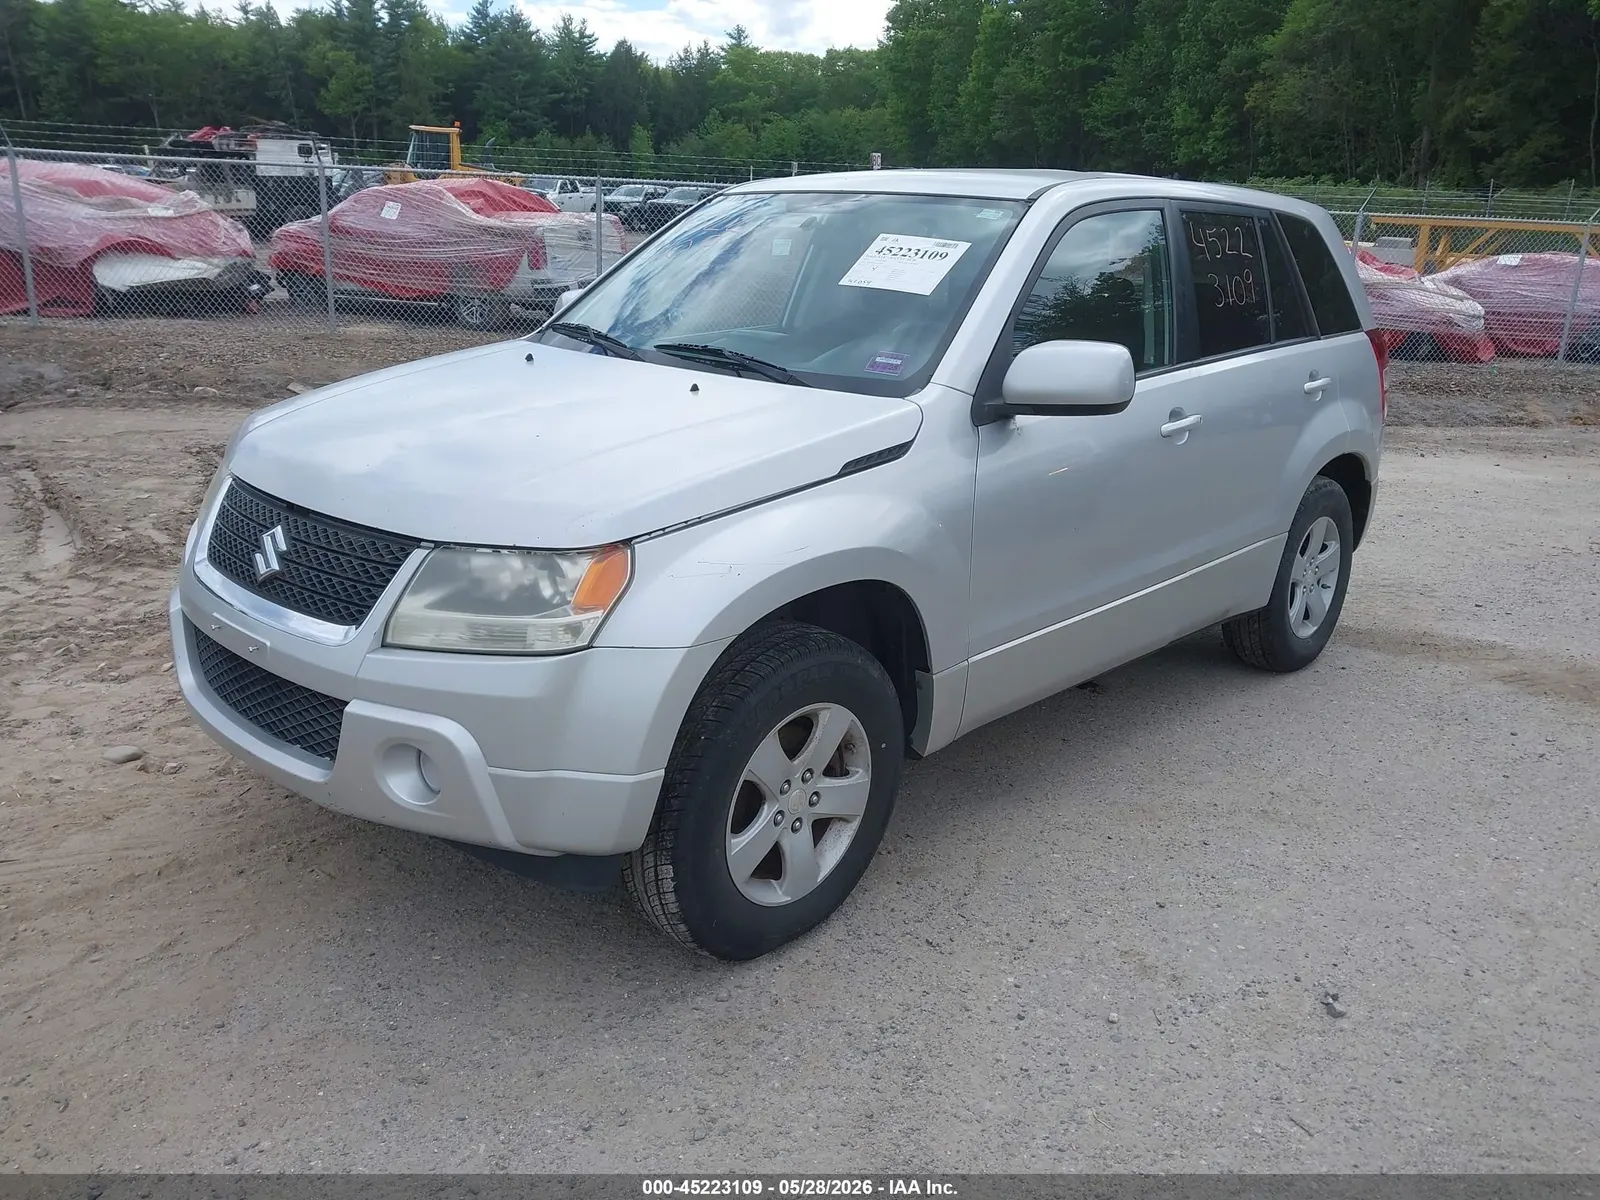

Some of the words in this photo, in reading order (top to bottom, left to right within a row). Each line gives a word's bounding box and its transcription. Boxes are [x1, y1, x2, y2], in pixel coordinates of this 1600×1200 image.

[875, 245, 949, 261] 45223109
[1189, 221, 1253, 261] 4522
[1208, 268, 1255, 307] 3109
